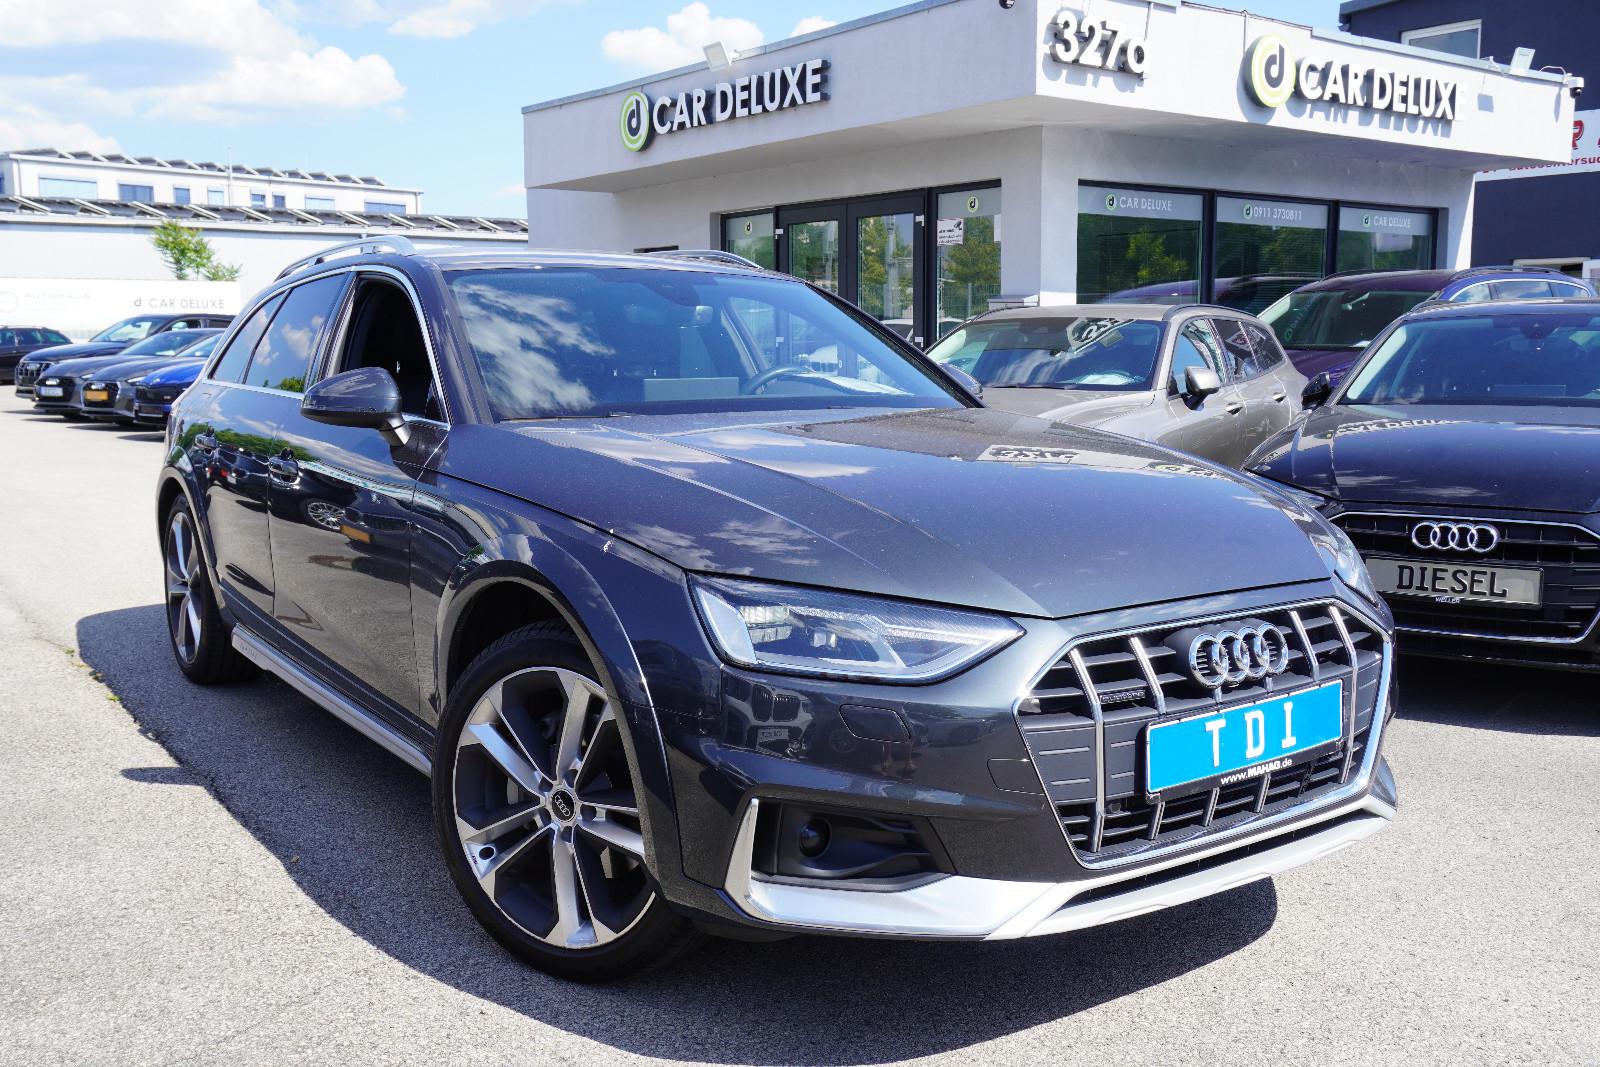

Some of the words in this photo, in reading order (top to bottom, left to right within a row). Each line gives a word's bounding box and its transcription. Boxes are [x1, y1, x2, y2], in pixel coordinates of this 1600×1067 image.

[652, 88, 707, 135] CAR
[715, 59, 823, 122] DELUXE
[1299, 55, 1366, 107] CAR
[1372, 67, 1466, 120] DELUXE
[1119, 196, 1139, 209] CAR
[1141, 198, 1173, 212] DELUXE
[1253, 206, 1271, 218] 0911
[148, 298, 175, 309] CAR
[180, 298, 225, 309] DELUXE
[1396, 564, 1508, 598] DIESEL
[1220, 757, 1293, 785] www.MAHAG.de
